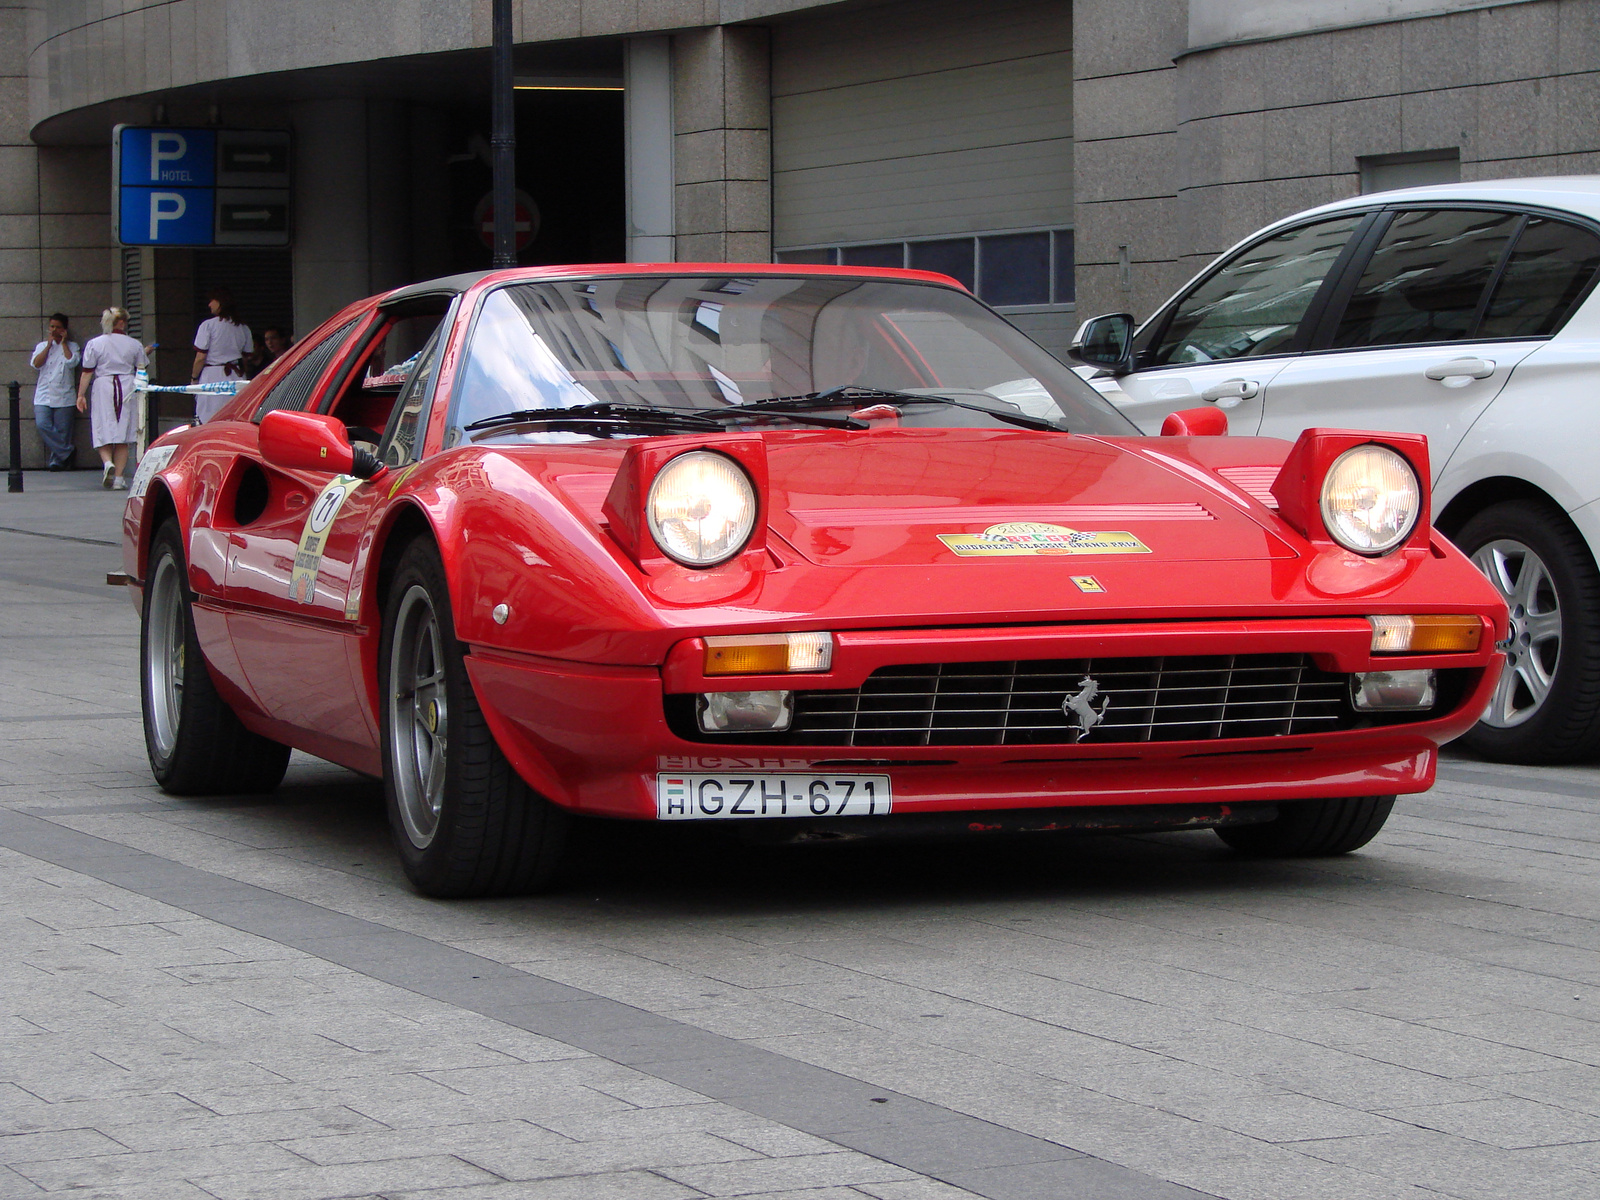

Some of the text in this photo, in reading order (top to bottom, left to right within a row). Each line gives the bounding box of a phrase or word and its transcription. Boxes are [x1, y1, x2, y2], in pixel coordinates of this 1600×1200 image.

[151, 133, 193, 181] P HOTEL
[149, 192, 187, 240] P
[315, 493, 341, 523] 71
[954, 544, 1016, 552] BUDAPEST
[1069, 541, 1110, 549] GRAND
[1112, 540, 1142, 548] PRIX
[667, 798, 685, 815] H
[698, 778, 875, 815] GZH-671
